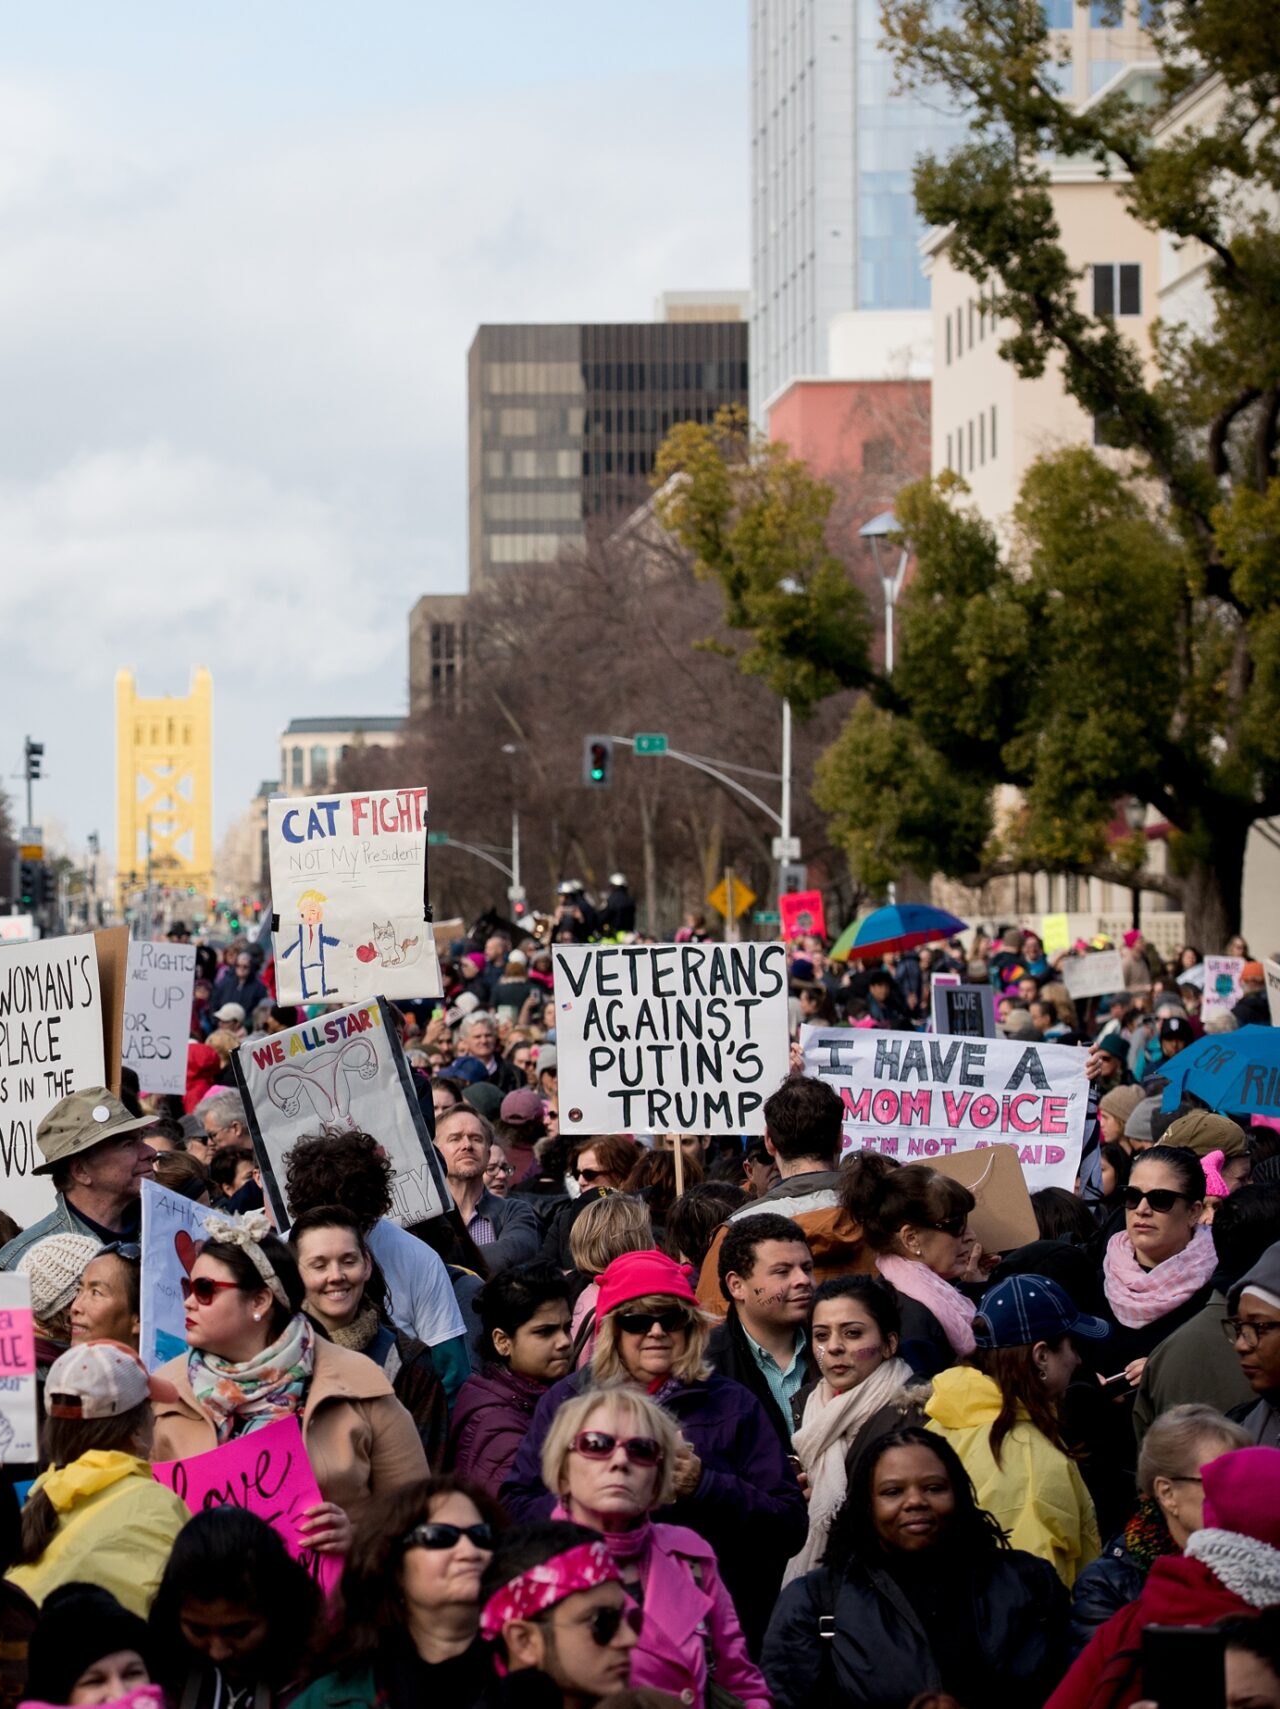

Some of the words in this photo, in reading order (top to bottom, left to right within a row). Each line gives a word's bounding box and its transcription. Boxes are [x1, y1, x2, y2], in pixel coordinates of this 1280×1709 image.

[282, 801, 341, 844] CAT
[351, 789, 427, 836] FIGHT
[289, 848, 325, 871] NOT
[362, 840, 422, 865] President
[140, 943, 195, 972] RIGHTS
[556, 945, 785, 998] VETERANS
[132, 969, 149, 981] ARE
[152, 986, 184, 1009] UP
[953, 993, 977, 1010] LOVE
[123, 1012, 151, 1032] OR
[583, 998, 763, 1042] AGAINST
[122, 1036, 172, 1060] ABS
[252, 1040, 286, 1071] WE
[289, 1027, 325, 1057] ALL
[324, 1005, 382, 1044] START
[589, 1041, 763, 1087] PUTIN'S
[818, 1039, 854, 1076] I
[873, 1039, 988, 1087] HAVE
[1004, 1046, 1052, 1090] A
[19, 1077, 35, 1103] IN
[43, 1068, 75, 1098] THE
[608, 1089, 763, 1128] TRUMP
[862, 1136, 898, 1155] I'M
[907, 1137, 957, 1157] NOT
